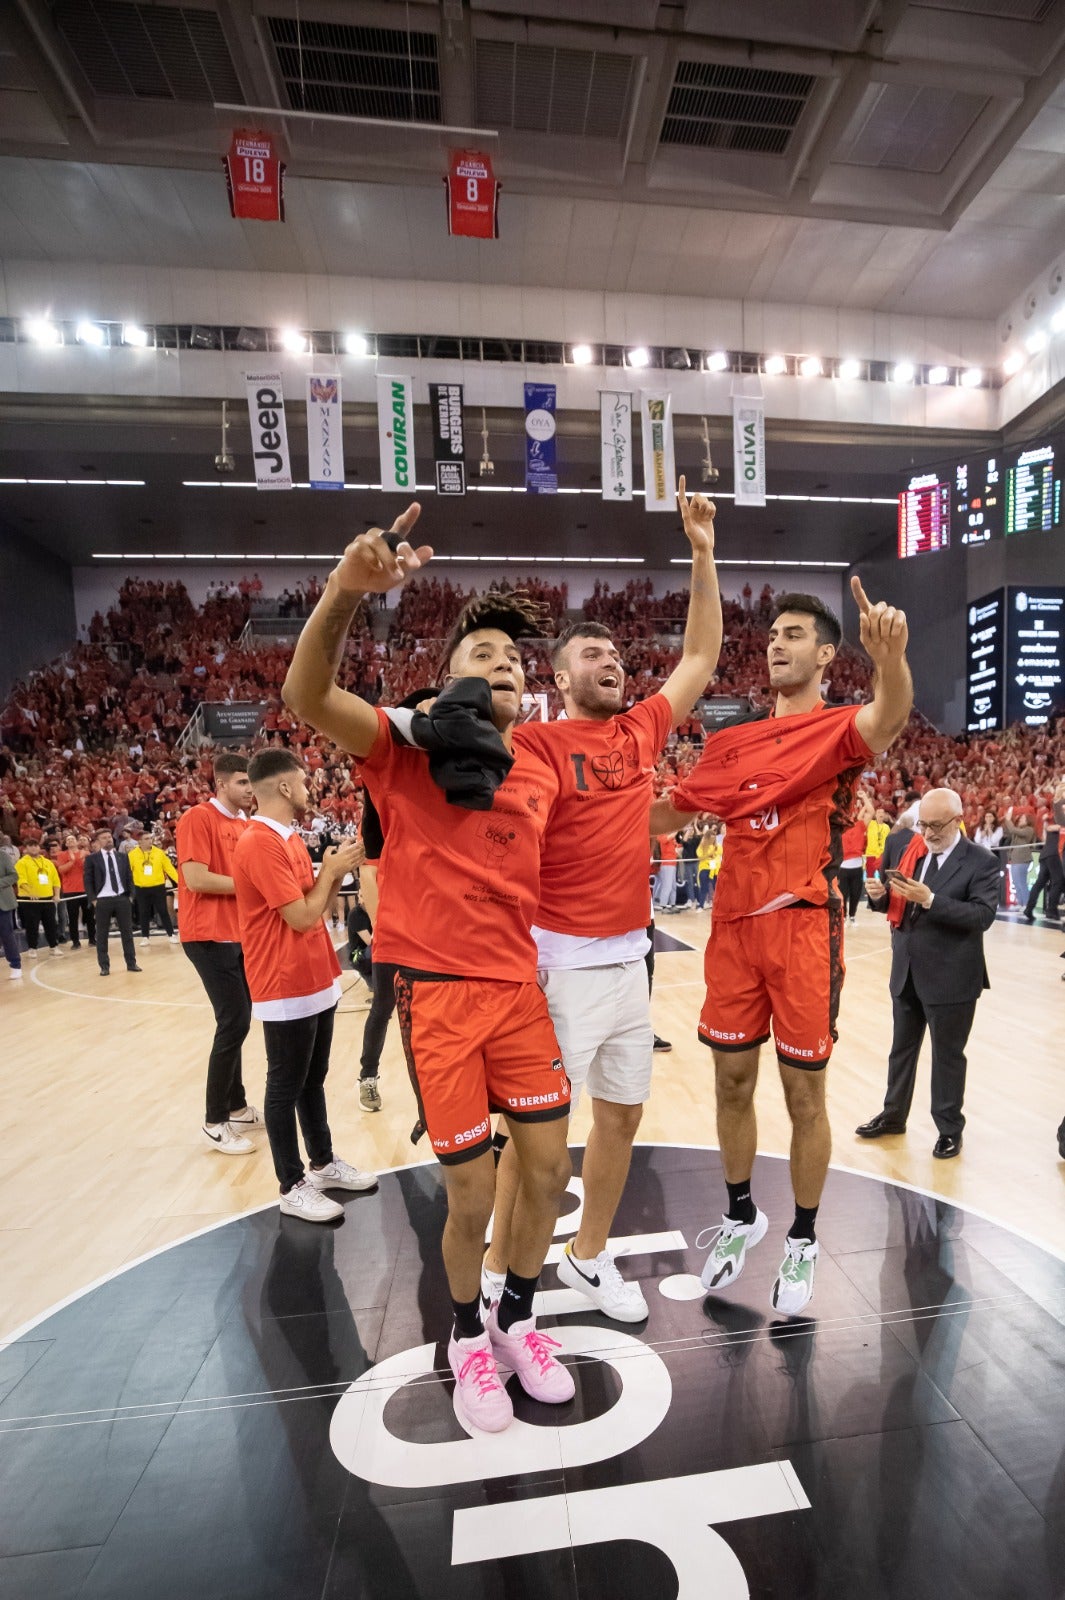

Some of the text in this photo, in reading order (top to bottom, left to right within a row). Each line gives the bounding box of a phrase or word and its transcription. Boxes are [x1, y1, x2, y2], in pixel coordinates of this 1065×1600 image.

[239, 148, 268, 156] PULEVA
[244, 158, 265, 183] 18
[460, 168, 486, 178] PULEVA
[466, 178, 478, 202] 8
[438, 386, 450, 439] DE VERDAD
[448, 386, 464, 454] BURGERS
[254, 388, 284, 474] Jeep
[320, 407, 332, 478] MANZANO
[744, 423, 756, 481] OLIVA
[571, 754, 590, 791] I
[710, 1028, 736, 1040] asisa
[780, 1042, 814, 1058] BERNER
[520, 1092, 560, 1106] BERNER
[454, 1122, 487, 1145] asisa
